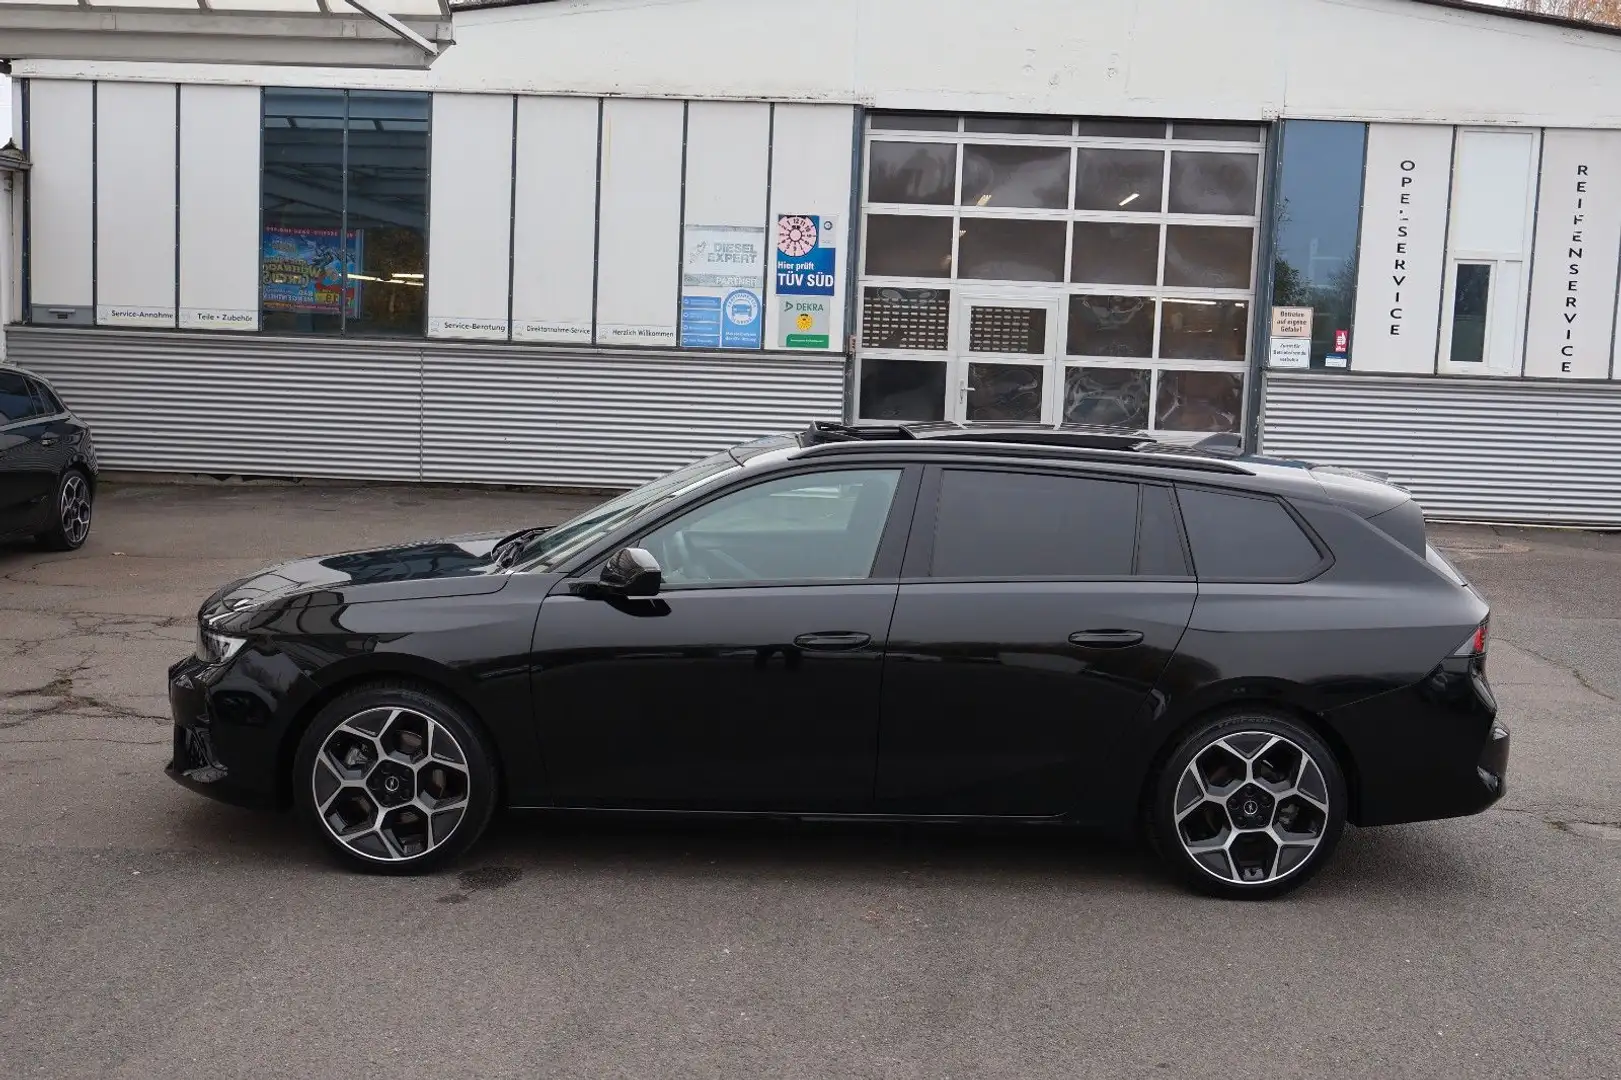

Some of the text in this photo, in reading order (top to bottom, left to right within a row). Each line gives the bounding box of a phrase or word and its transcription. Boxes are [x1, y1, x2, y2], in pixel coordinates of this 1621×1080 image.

[713, 243, 758, 253] DIESEL
[707, 252, 757, 264] EXPERT
[777, 261, 815, 272] Hier prüft
[1561, 165, 1589, 373] REIFENSERVICE
[777, 270, 834, 287] TÜV SÜD
[796, 302, 824, 312] DEKRA
[111, 310, 174, 319] Service-Annahme
[197, 312, 253, 322] Teile Zubehör
[444, 321, 506, 332] Service-Beratung
[638, 329, 674, 338] Willkommen
